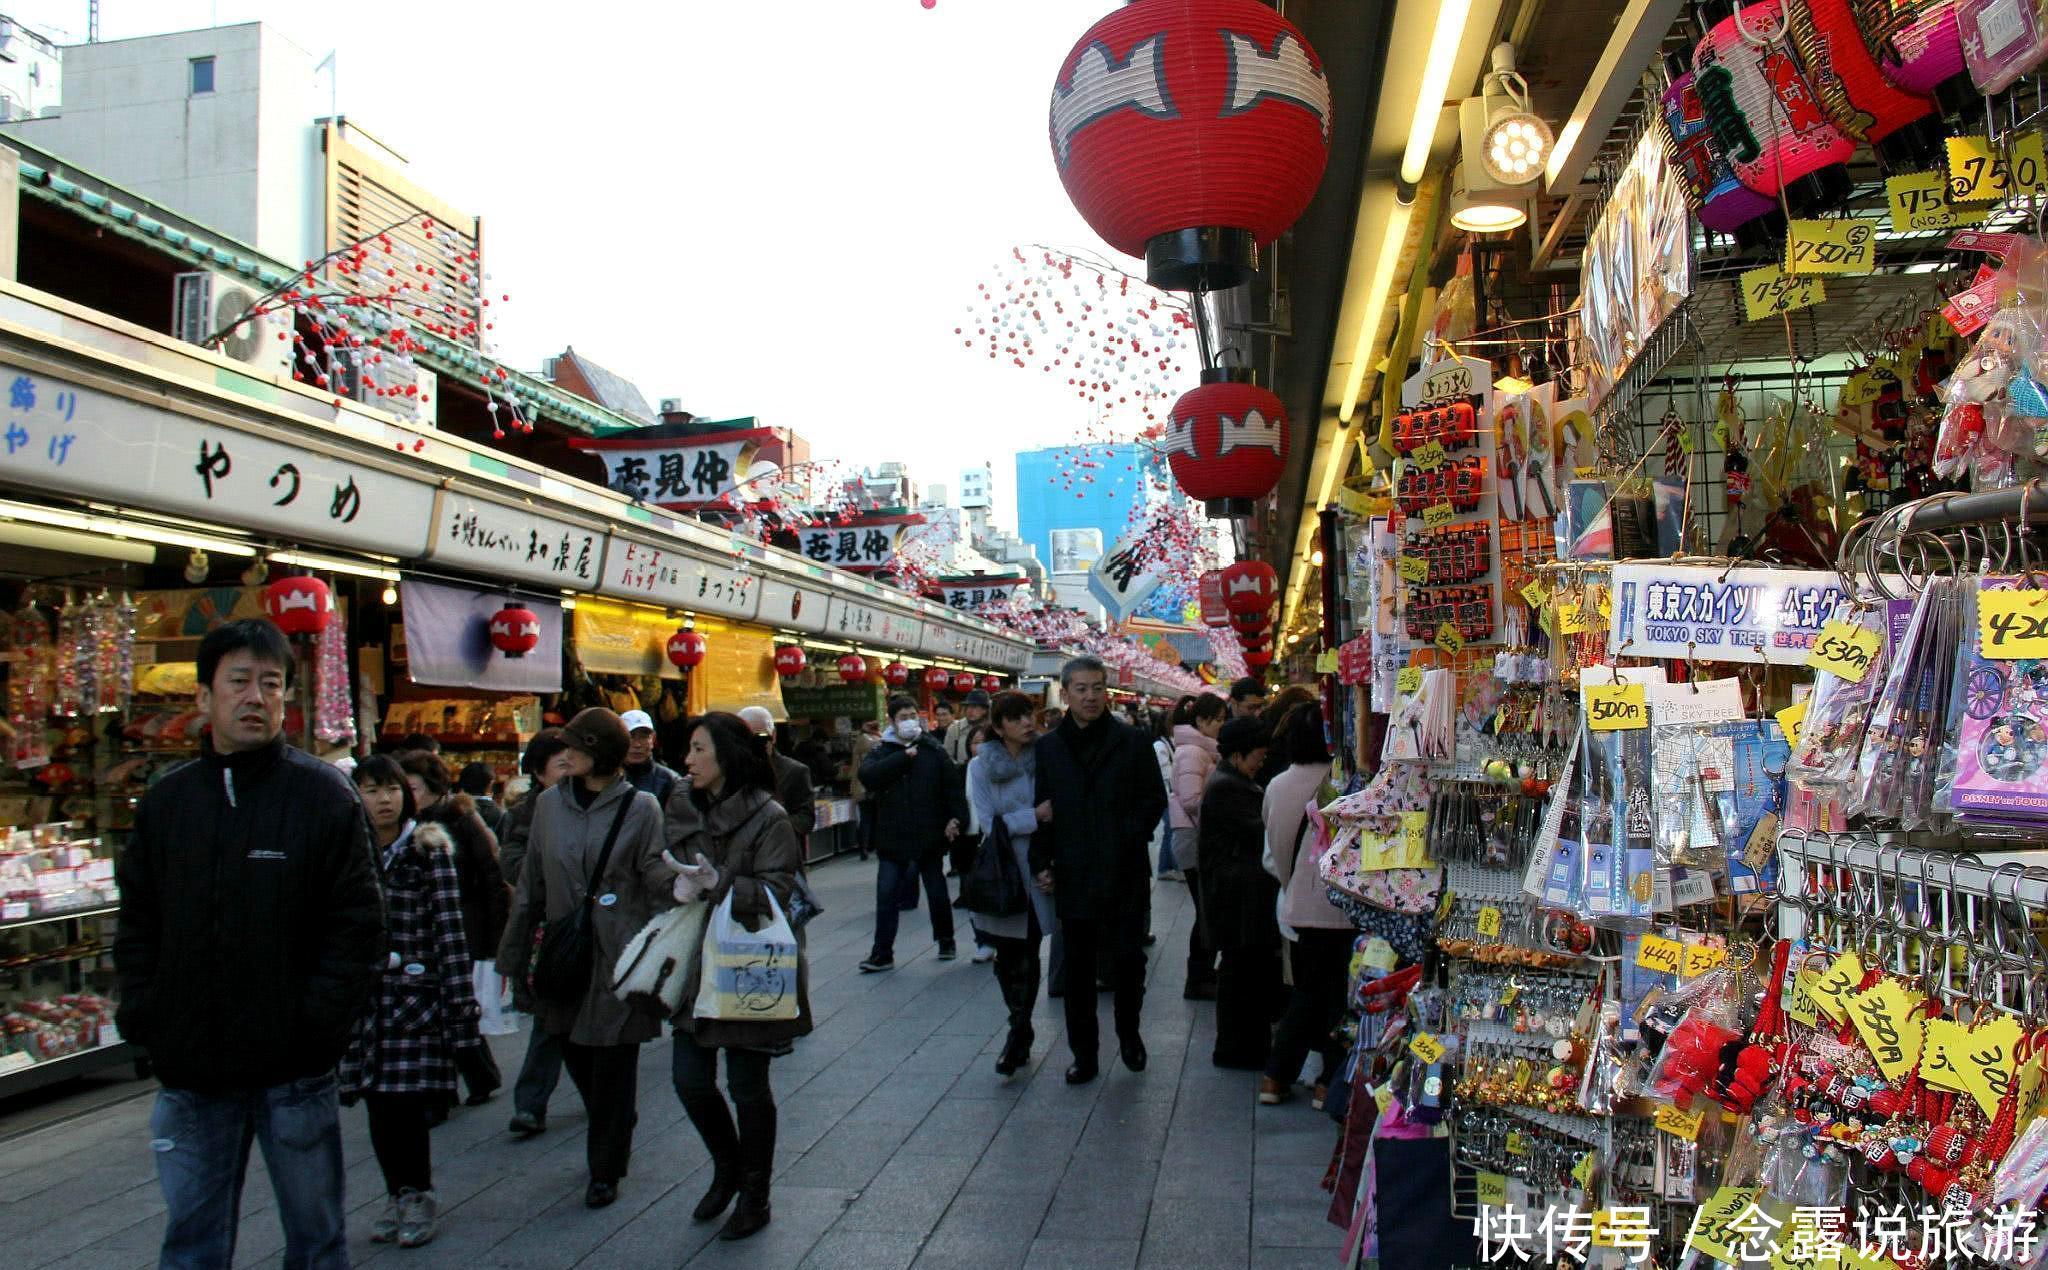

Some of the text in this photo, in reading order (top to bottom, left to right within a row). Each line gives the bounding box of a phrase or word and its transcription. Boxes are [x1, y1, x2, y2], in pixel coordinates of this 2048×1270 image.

[1795, 240, 1865, 264] 750円
[195, 437, 361, 523] やつめ
[1646, 624, 1767, 647] TOKYO SKY TREE
[1815, 635, 1868, 670] 530円
[1592, 698, 1639, 720] 500円
[1858, 996, 1903, 1064] 350円
